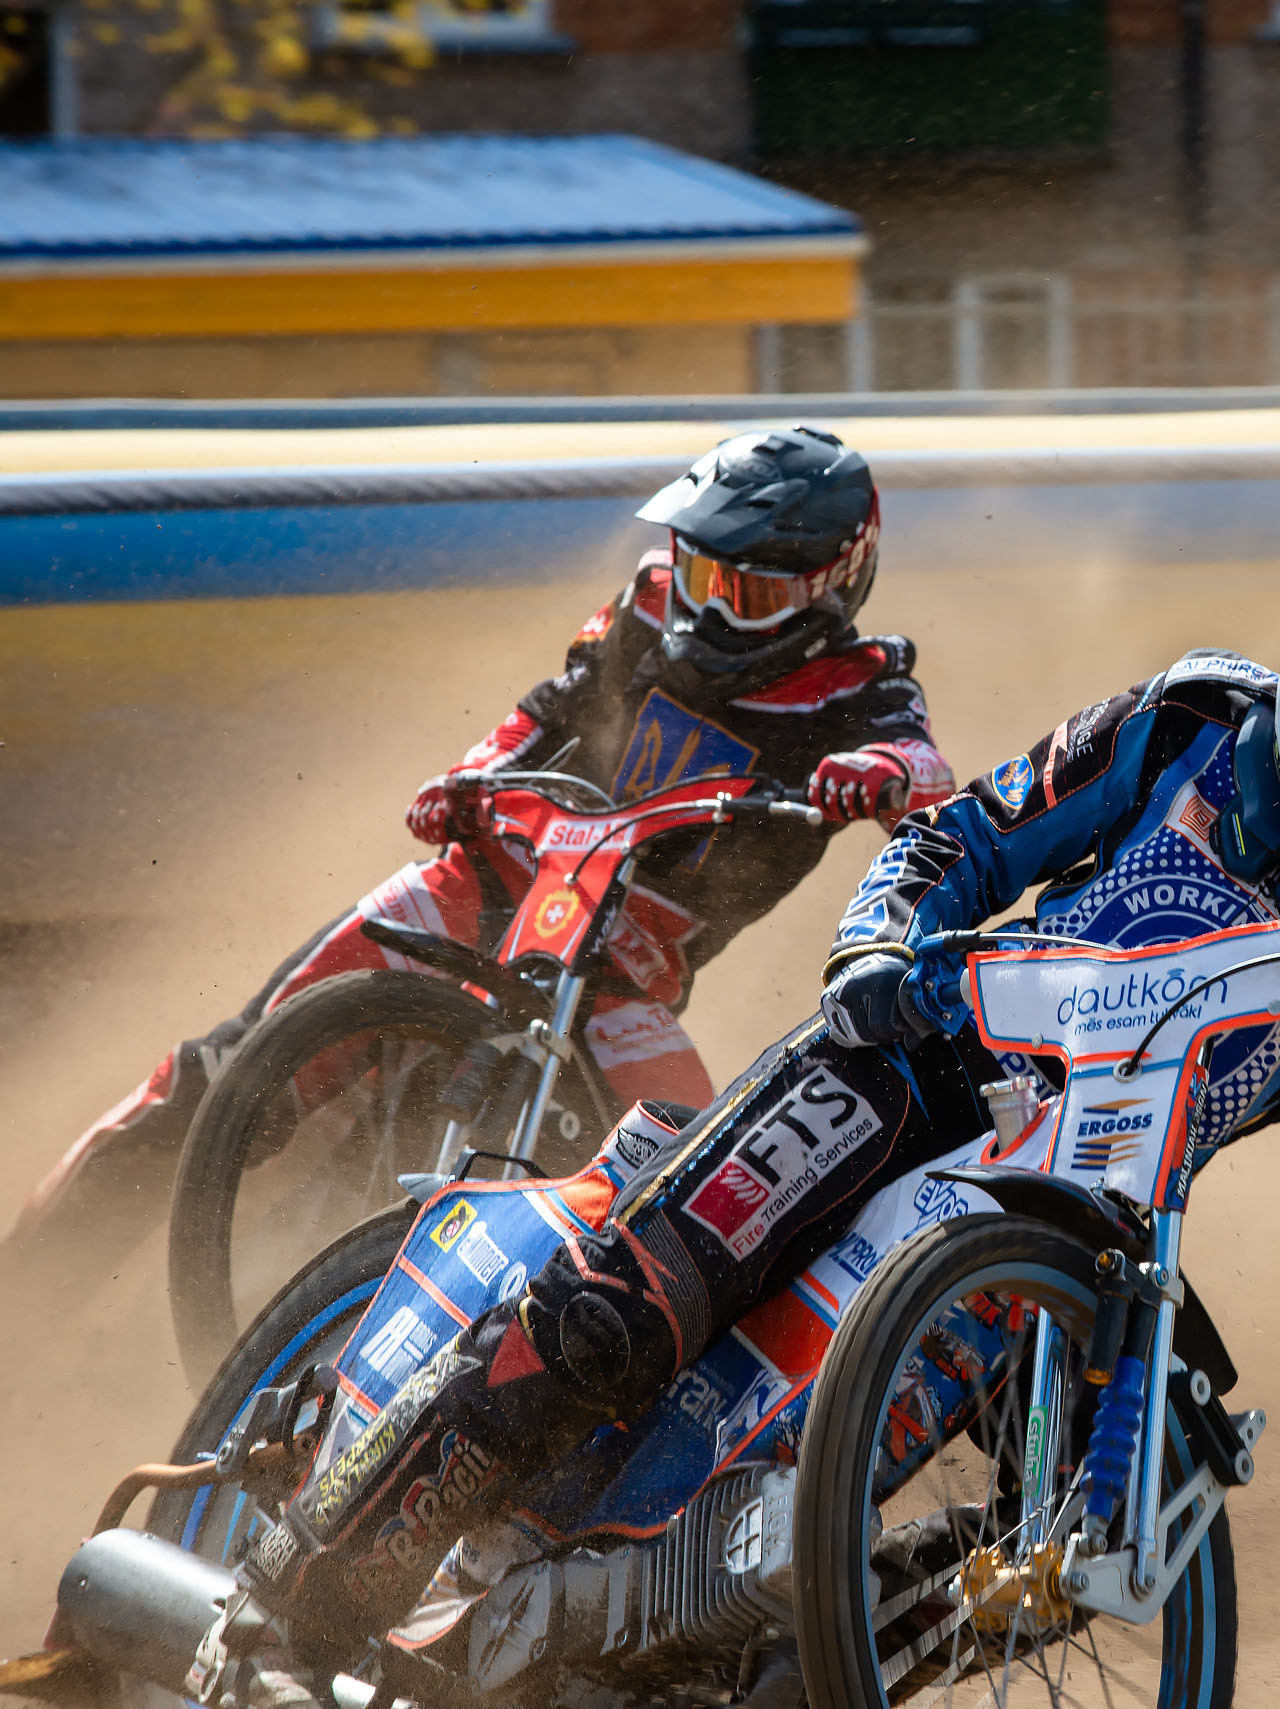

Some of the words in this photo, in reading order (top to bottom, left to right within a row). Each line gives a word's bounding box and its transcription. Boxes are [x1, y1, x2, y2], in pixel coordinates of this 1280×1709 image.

[1106, 1014, 1146, 1031] esam
[734, 1075, 858, 1188] FTS
[1077, 1112, 1154, 1137] ERGOSS
[732, 1222, 766, 1255] Fire
[761, 1166, 819, 1222] Training
[814, 1117, 873, 1170] Services
